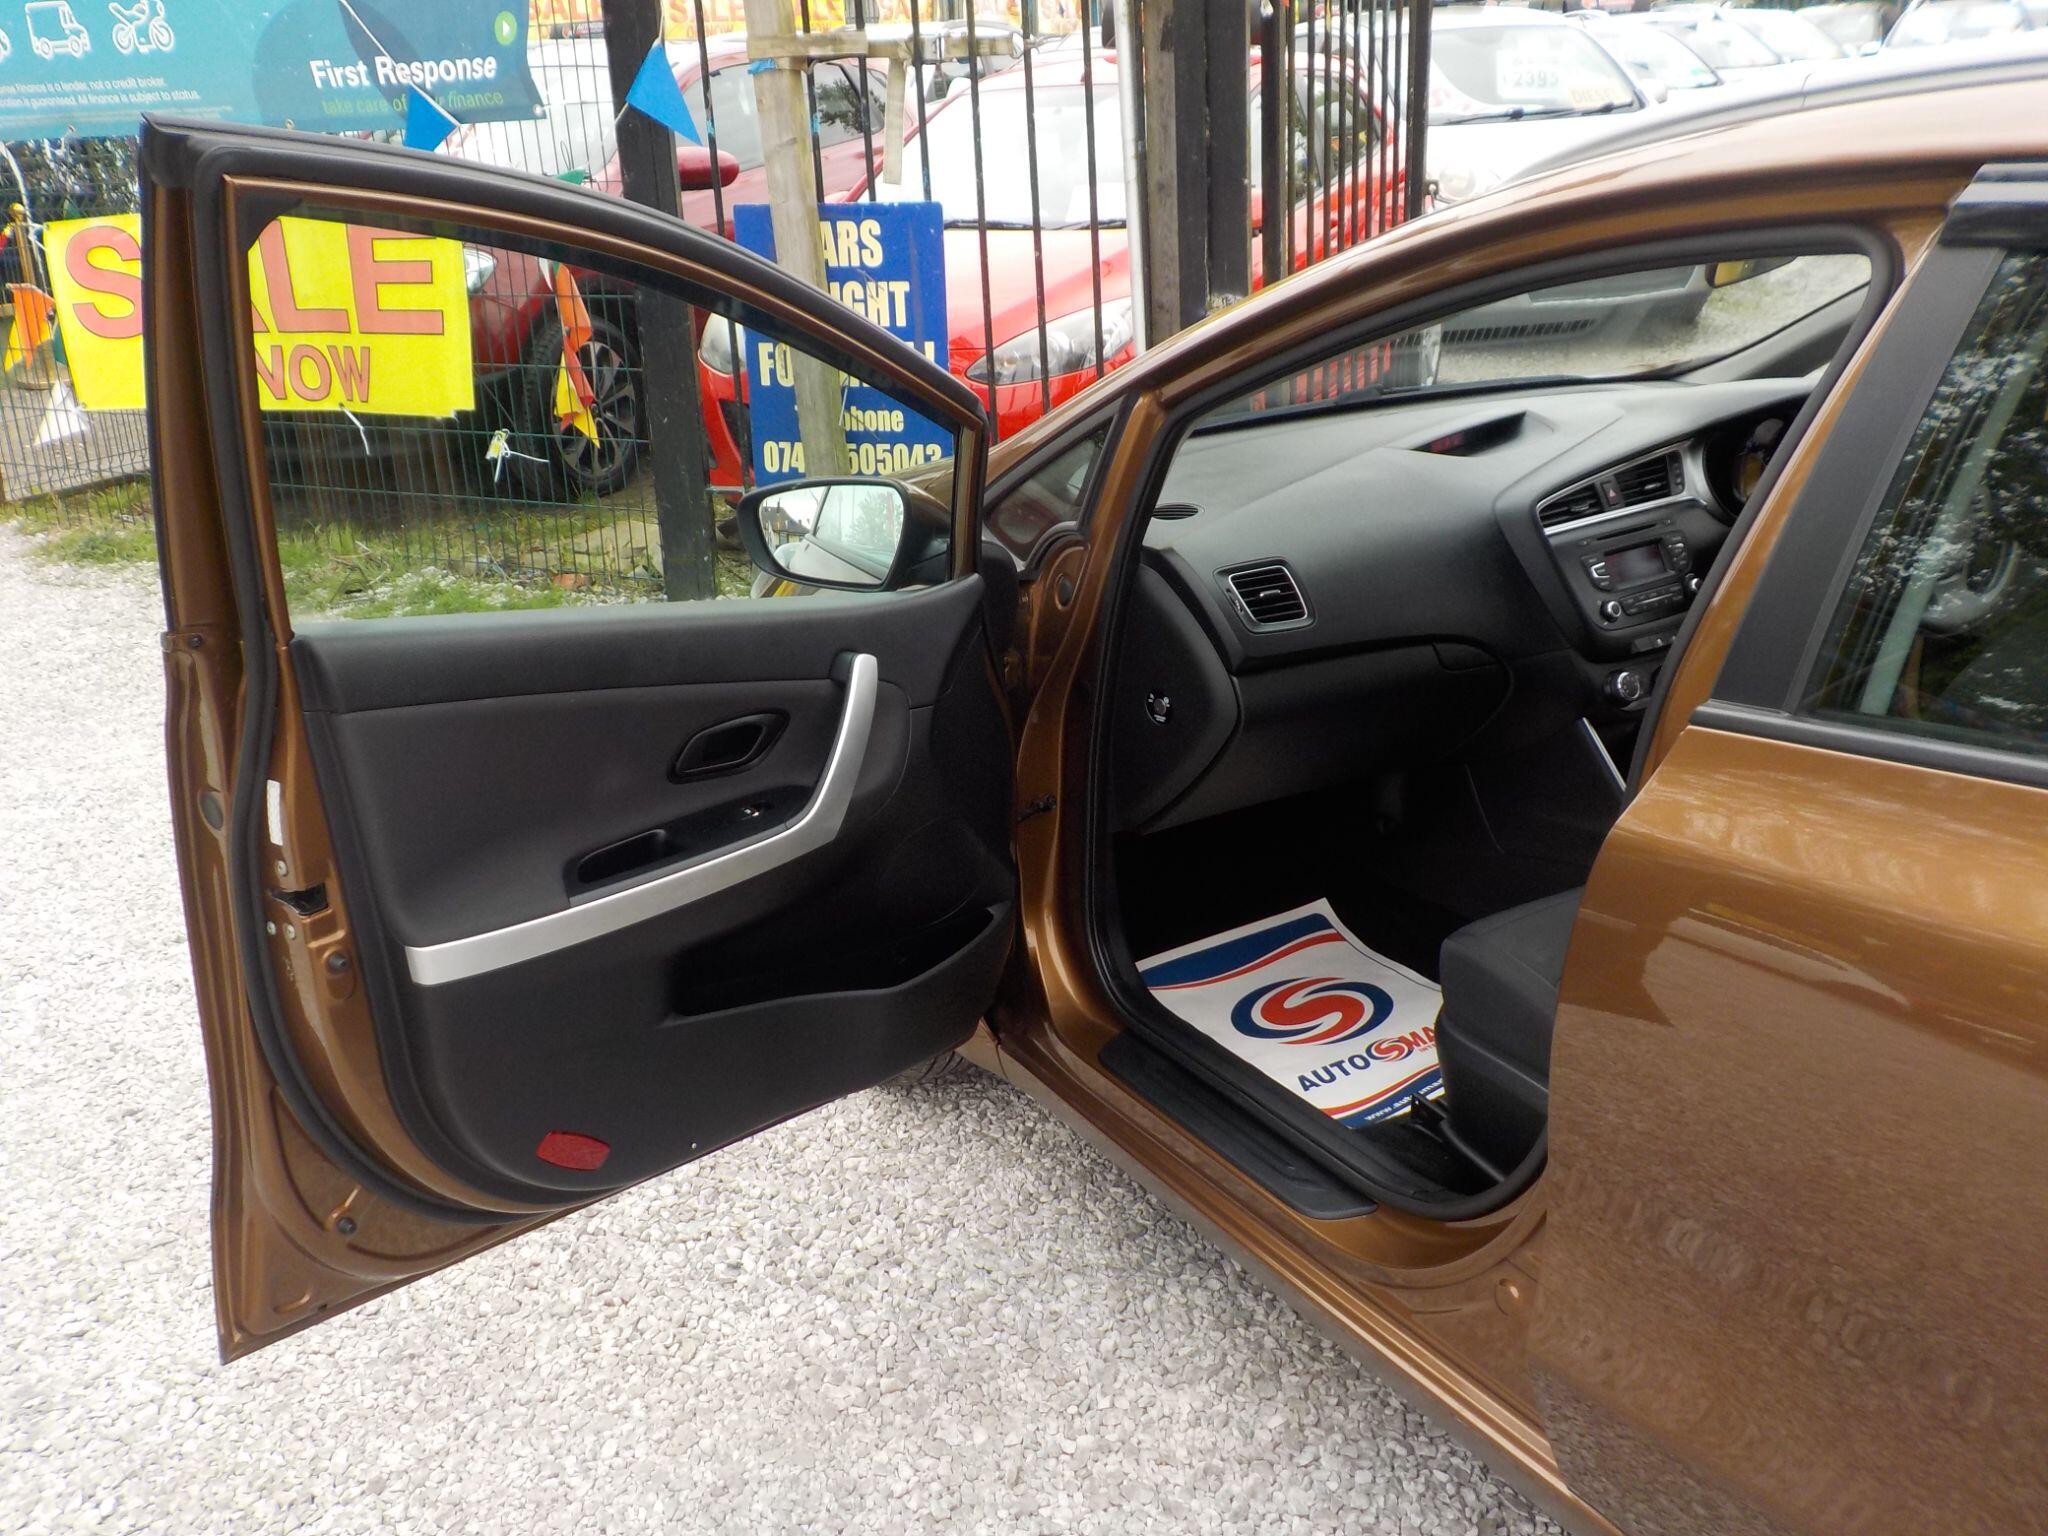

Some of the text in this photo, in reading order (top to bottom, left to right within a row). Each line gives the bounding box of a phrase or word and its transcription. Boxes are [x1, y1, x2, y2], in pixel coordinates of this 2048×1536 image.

[309, 54, 498, 90] First Response
[321, 101, 352, 116] take
[356, 100, 388, 114] care
[393, 94, 408, 112] of
[449, 90, 505, 109] finance
[820, 219, 884, 268] ARS
[65, 219, 445, 340] SLE
[829, 280, 911, 328] GHT
[255, 344, 371, 402] NOW
[758, 341, 796, 388] FO
[841, 405, 905, 432] phone
[763, 440, 806, 474] 074
[1297, 1025, 1438, 1092] AUTOSMA
